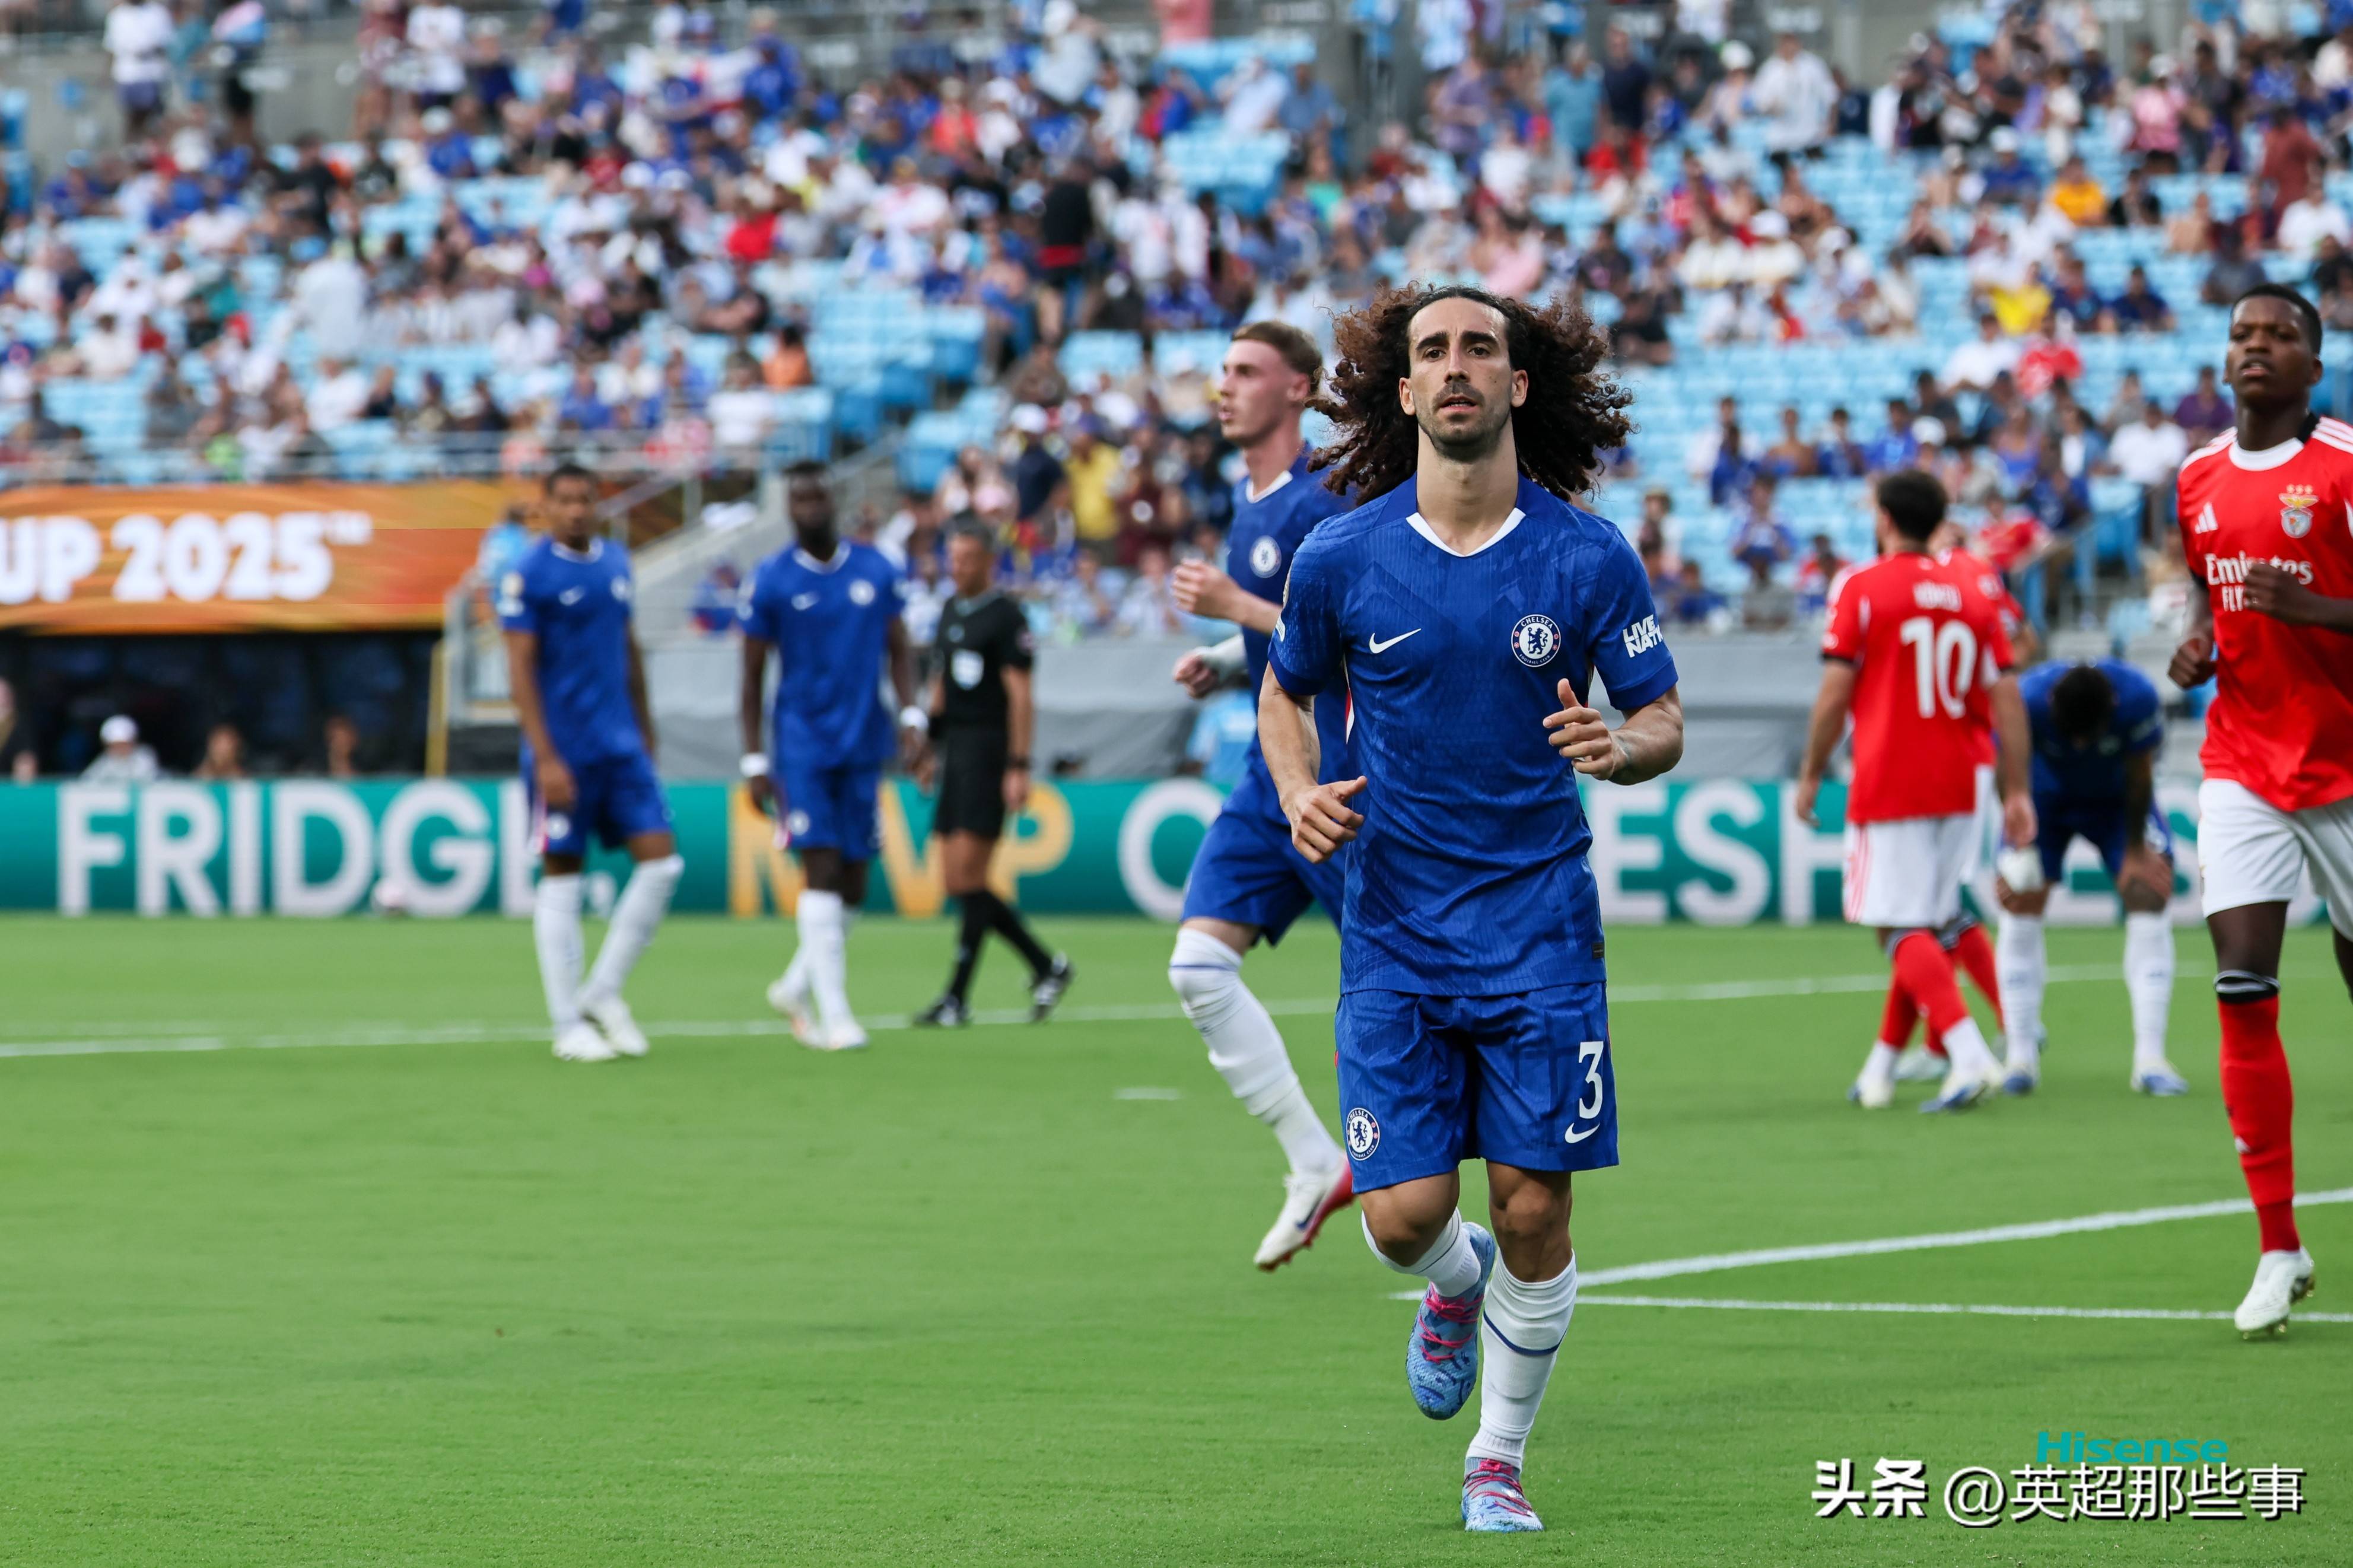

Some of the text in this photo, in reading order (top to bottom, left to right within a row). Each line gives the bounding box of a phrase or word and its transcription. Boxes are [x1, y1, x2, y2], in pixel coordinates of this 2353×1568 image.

[112, 510, 333, 602] 2025
[2222, 584, 2244, 612] FLY
[1521, 616, 1553, 629] CHELSEA
[1623, 614, 1655, 643] LIVE
[1519, 654, 1538, 664] FOOTBALL
[1900, 615, 1977, 720] 10
[1579, 1041, 1604, 1119] 3
[1348, 1109, 1368, 1124] CHELSEA
